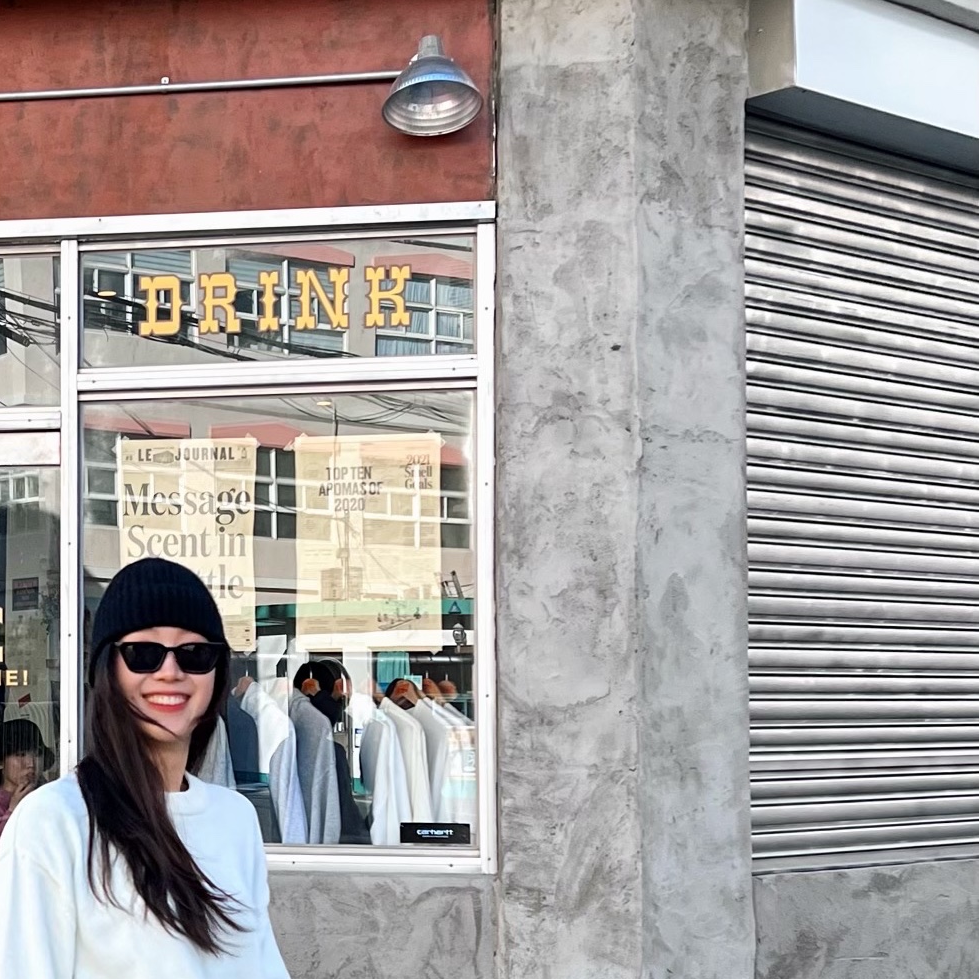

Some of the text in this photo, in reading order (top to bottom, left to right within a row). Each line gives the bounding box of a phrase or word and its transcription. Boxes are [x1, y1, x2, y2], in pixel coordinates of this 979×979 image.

[138, 264, 412, 338] DRINK
[138, 448, 152, 462] LE
[174, 446, 235, 461] JOURNAL
[406, 454, 430, 466] 2021
[326, 465, 372, 480] TOP TEN
[123, 483, 251, 525] Message
[334, 497, 365, 512] 2020
[127, 524, 246, 558] Scent in
